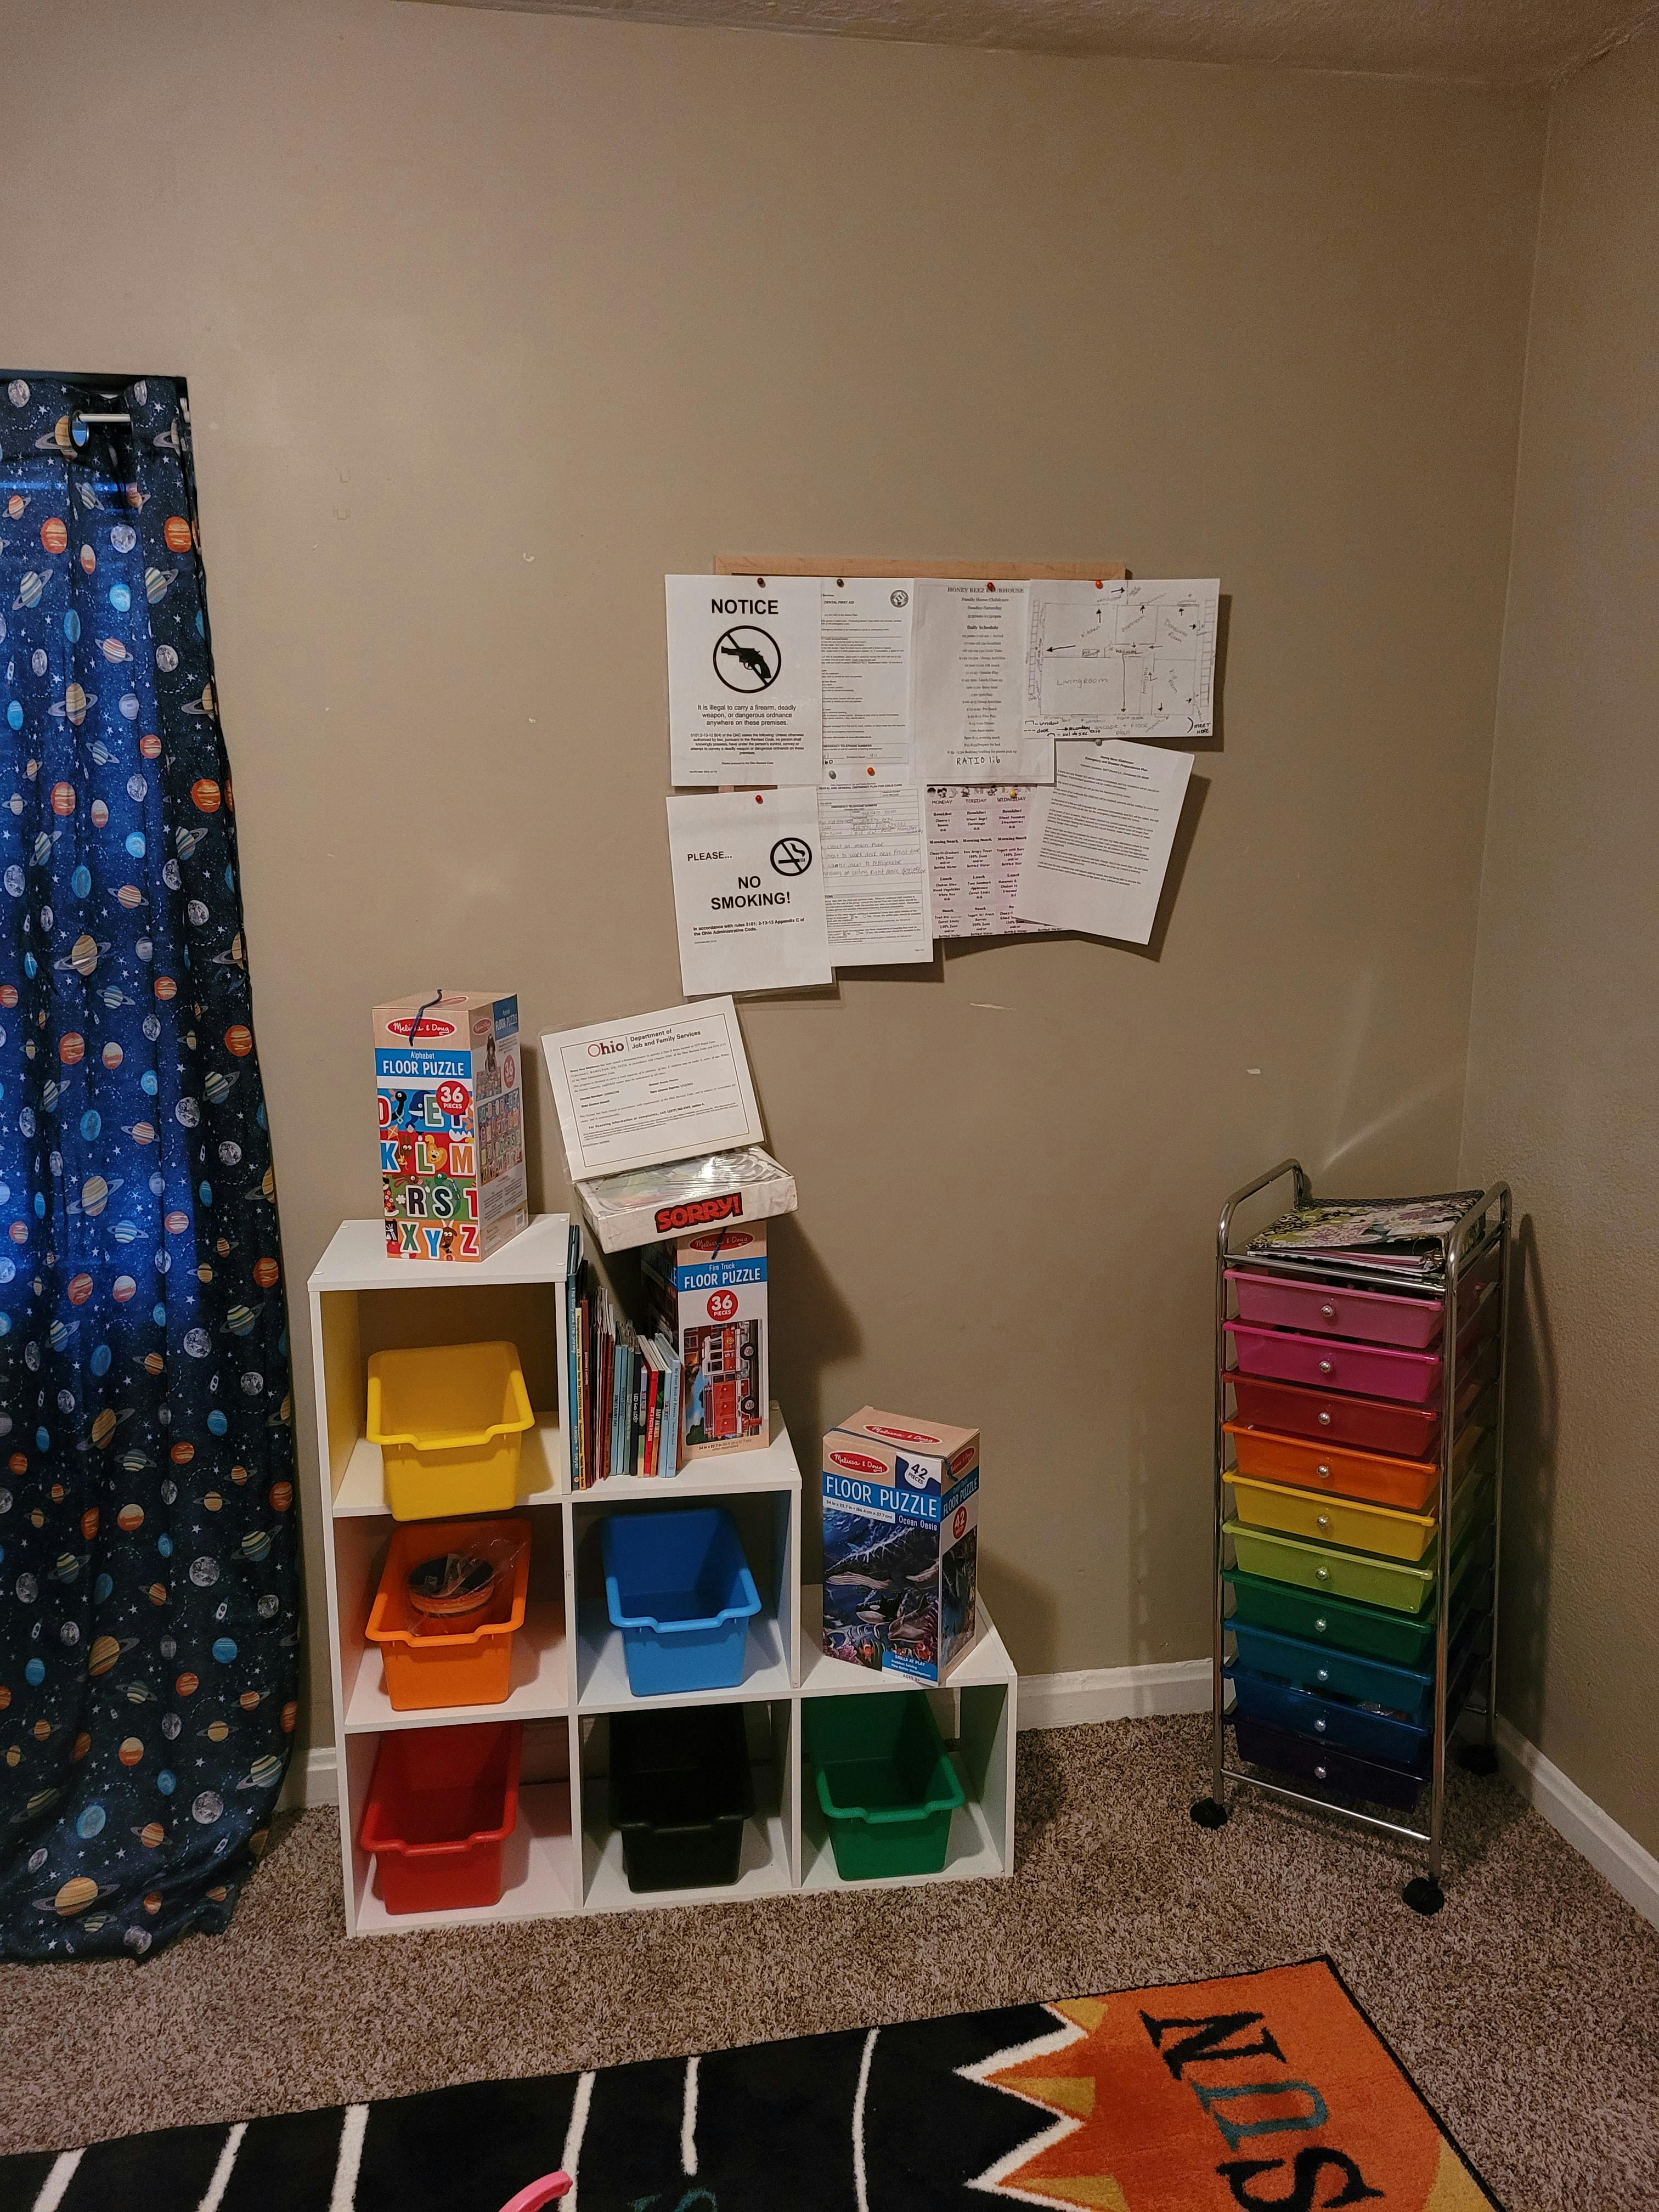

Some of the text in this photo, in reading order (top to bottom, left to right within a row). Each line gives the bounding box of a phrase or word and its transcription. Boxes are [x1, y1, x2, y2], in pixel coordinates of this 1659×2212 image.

[712, 599, 778, 614] NOTICE
[687, 851, 732, 861] PLEASE...
[738, 876, 761, 889] NO
[711, 891, 791, 910] SMOKING!
[432, 1024, 449, 1035] Doug
[630, 1031, 664, 1042] Department
[656, 1036, 675, 1044] Family
[676, 1031, 701, 1040] Services
[410, 1051, 435, 1060] Alphabet
[588, 1041, 624, 1057] Ohio
[383, 1060, 464, 1076] FLOOR PUZZLE
[441, 1086, 464, 1103] 36
[415, 1142, 436, 1174] L
[449, 1143, 476, 1176] M
[405, 1185, 428, 1217] R
[432, 1186, 453, 1218] S
[655, 1194, 742, 1232] SORRY!
[399, 1221, 479, 1259] X Y Z
[732, 1237, 747, 1245] Doug
[684, 1268, 760, 1289] FLOOR PUZZLE
[711, 1294, 733, 1311] 36
[834, 1454, 861, 1465] Melissa
[867, 1461, 883, 1472] Doug
[907, 1472, 924, 1485] PIECES
[911, 1464, 928, 1480] 42
[826, 1476, 937, 1518] FLOOR PUZZLE
[943, 1477, 978, 1517] FLOOR PUZZLE
[899, 1515, 938, 1531] Ocean Oasis
[955, 1510, 965, 1526] 42
